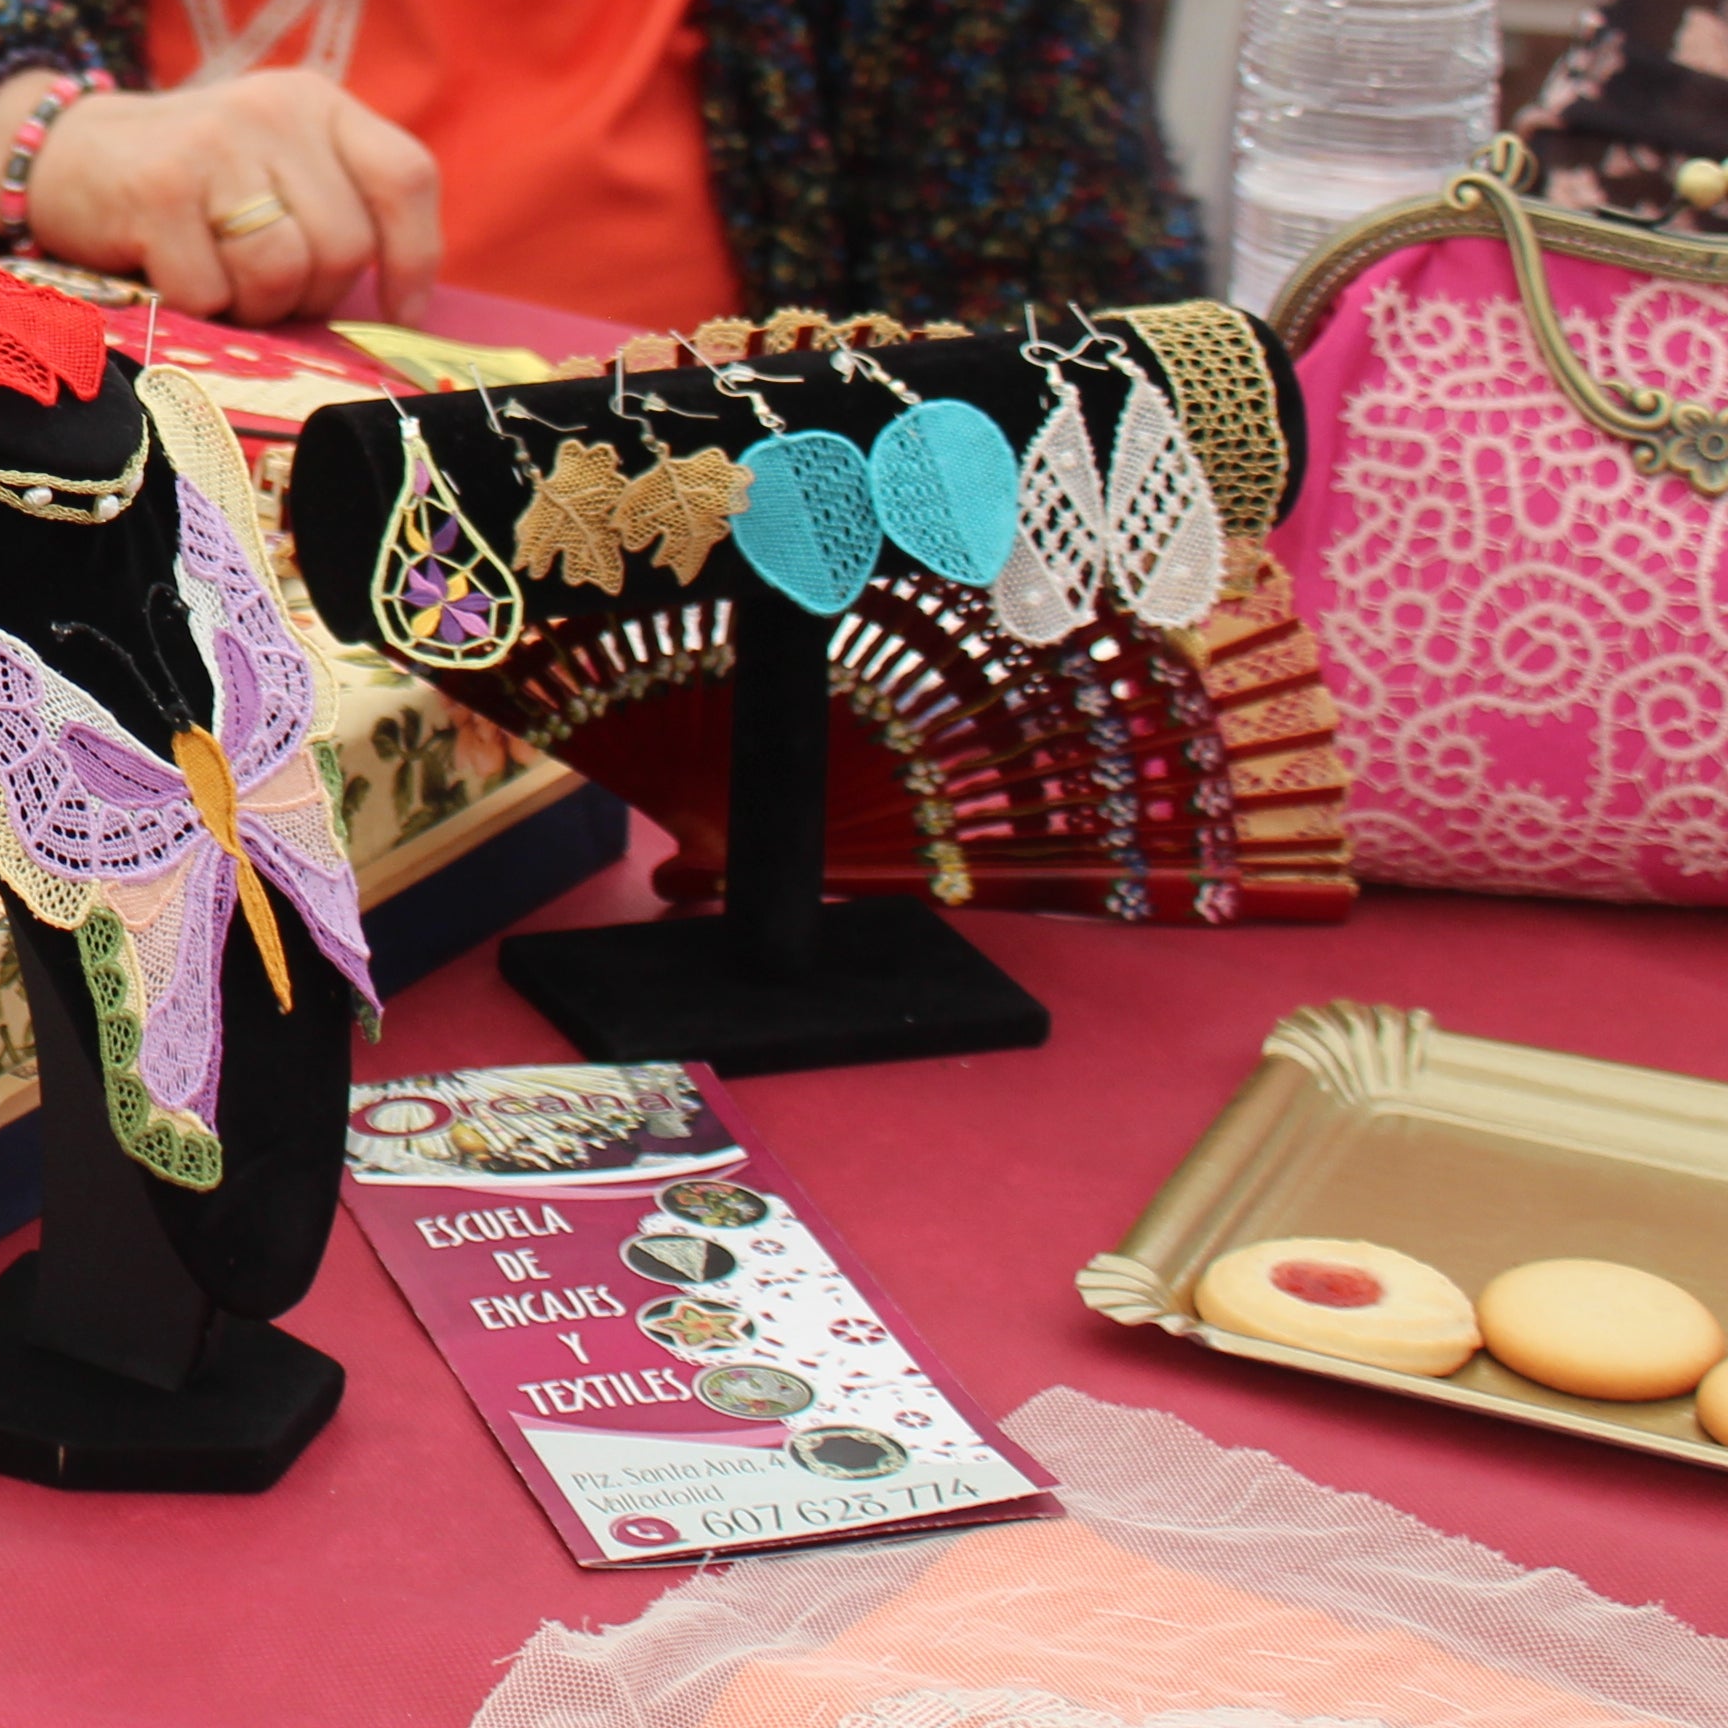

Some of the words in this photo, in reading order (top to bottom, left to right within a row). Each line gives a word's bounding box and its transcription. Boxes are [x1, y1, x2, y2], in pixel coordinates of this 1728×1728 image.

[415, 1203, 575, 1249] ESCUELA
[492, 1247, 552, 1282] DE
[469, 1284, 627, 1330] ENCAJES
[557, 1331, 590, 1364] Y
[517, 1368, 693, 1415] TEXTILES
[571, 1472, 623, 1492] Plz.
[622, 1462, 701, 1486] Santa
[768, 1452, 787, 1471] 4
[586, 1484, 725, 1515] Valladolid
[701, 1504, 783, 1539] 607
[796, 1493, 889, 1525] 628
[887, 1478, 980, 1509] 774
